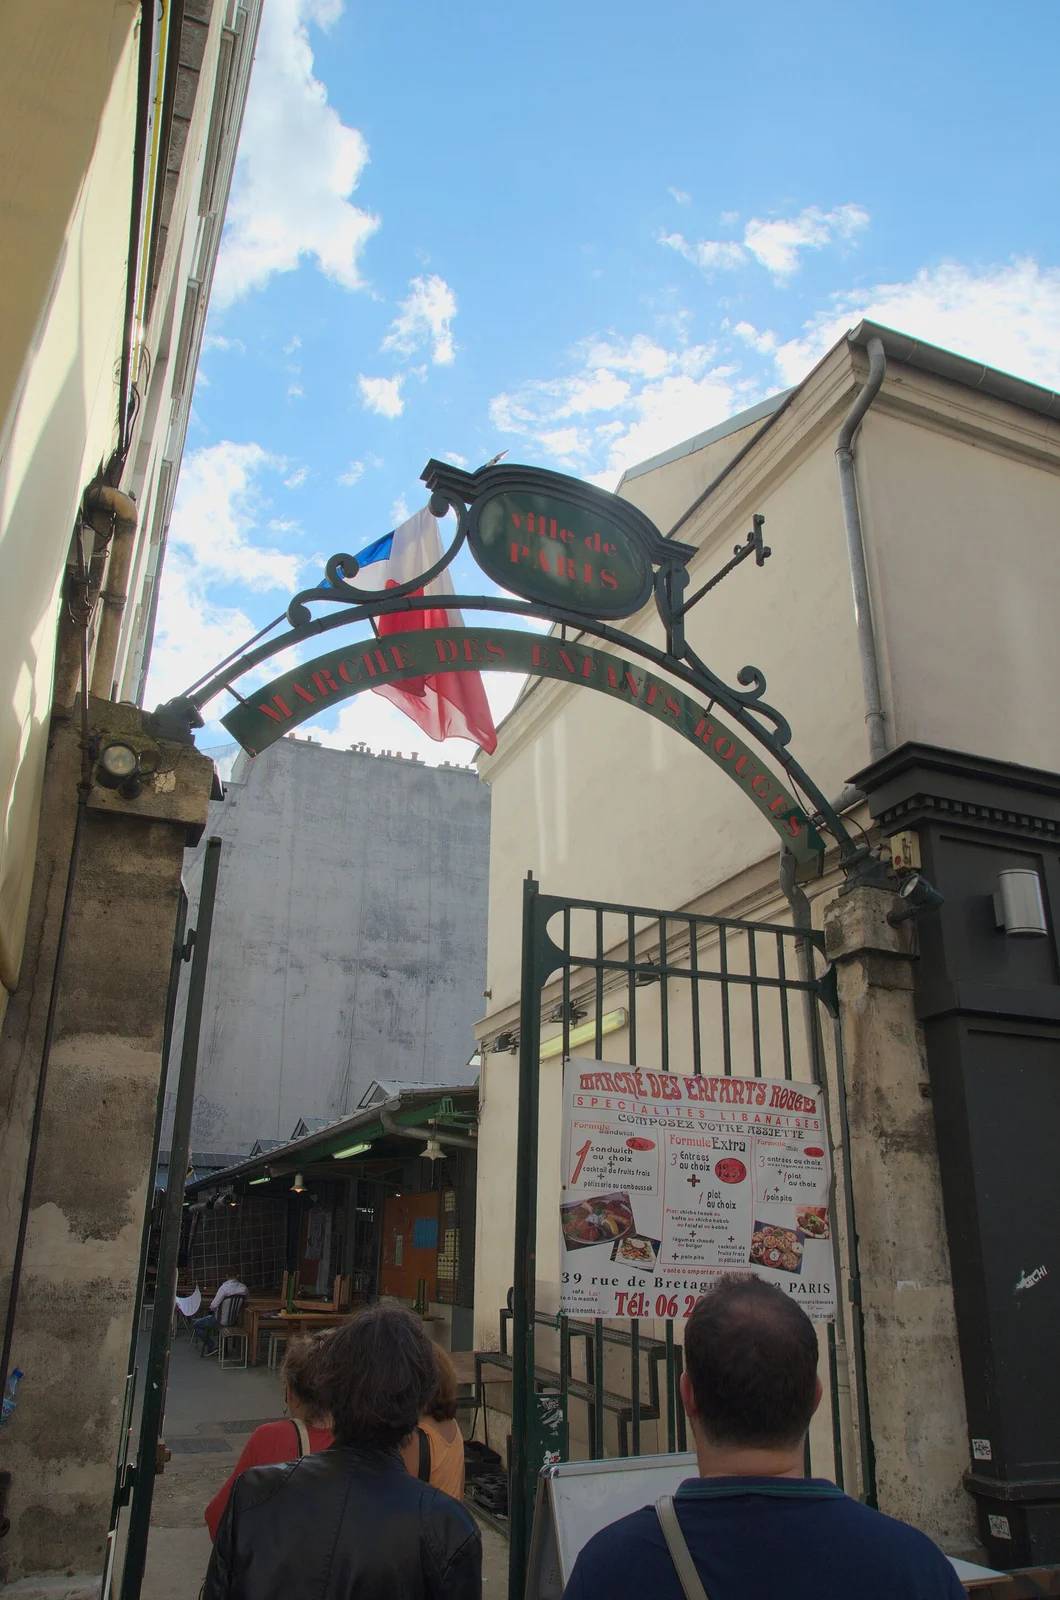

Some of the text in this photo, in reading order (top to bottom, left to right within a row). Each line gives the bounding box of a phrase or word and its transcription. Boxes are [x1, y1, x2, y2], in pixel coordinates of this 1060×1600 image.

[512, 511, 617, 556] ville de
[510, 542, 619, 590] PARIS
[258, 638, 804, 838] MARCHE DES ENFANTS ROUGES
[646, 1072, 682, 1100] DES
[683, 1075, 767, 1106] ENFANTS
[577, 1096, 819, 1129] SPECIALITES LIBANAISES
[574, 1121, 610, 1131] Formule
[618, 1113, 695, 1129] COMPOSEZ
[698, 1121, 744, 1133] VOTRE
[670, 1134, 711, 1148] Formule
[711, 1136, 746, 1153] Extra
[590, 1145, 633, 1155] sandwich
[608, 1155, 632, 1163] choix
[671, 1153, 678, 1166] 3
[583, 1165, 650, 1177] cocktail de fruits frais
[680, 1162, 710, 1172] au choix
[787, 1172, 802, 1180] plat
[799, 1180, 817, 1188] choix
[707, 1189, 721, 1200] plat
[766, 1193, 780, 1202] pain
[780, 1194, 793, 1202] pita
[717, 1200, 736, 1210] choix
[561, 1271, 582, 1284] 39
[591, 1275, 619, 1287] rue
[627, 1275, 646, 1288] de
[789, 1282, 831, 1294] PARIS
[614, 1291, 705, 1318] Tél: 06 2
